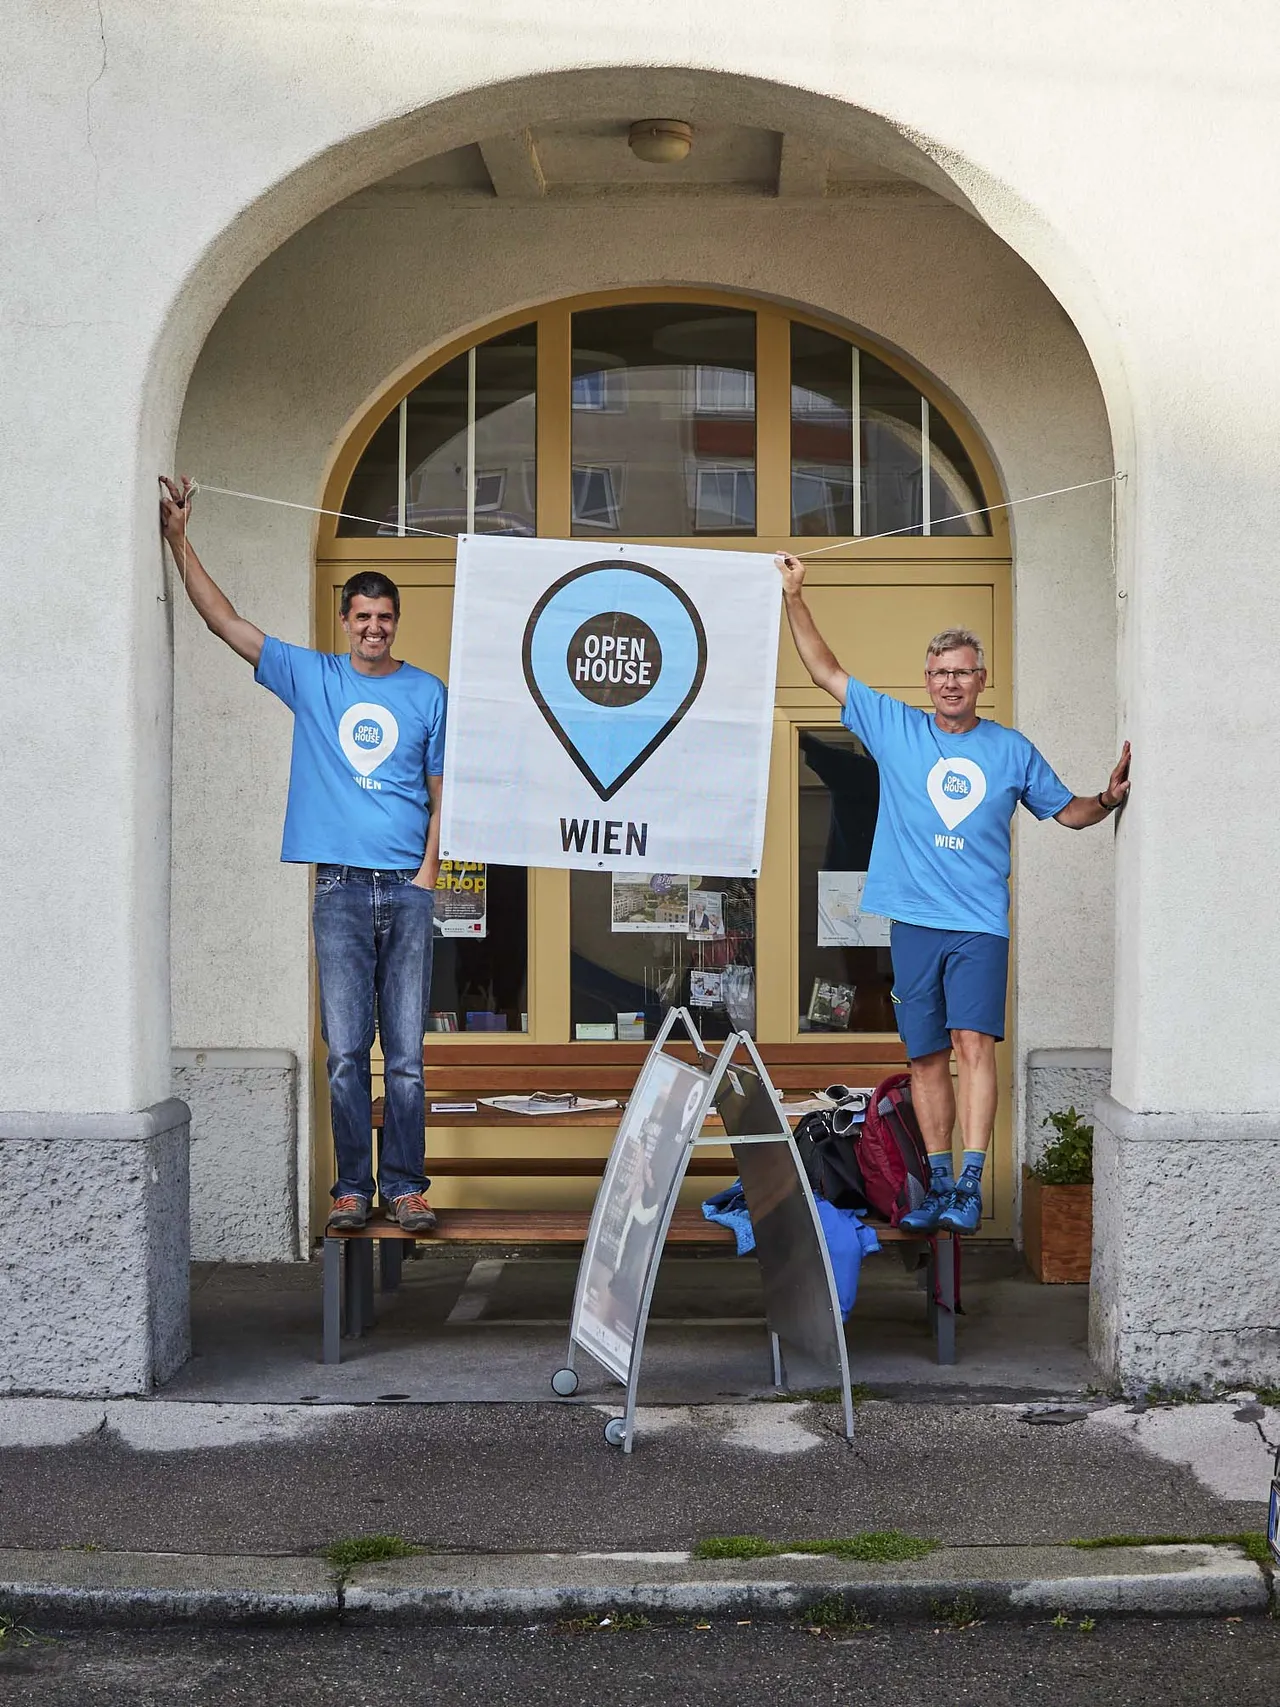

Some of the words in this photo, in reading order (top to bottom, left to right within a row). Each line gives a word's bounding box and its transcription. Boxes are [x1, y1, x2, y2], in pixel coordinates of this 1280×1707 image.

[583, 634, 645, 661] OPEN
[575, 658, 652, 685] HOUSE
[354, 732, 380, 744] HOUSE
[358, 725, 379, 735] OPEN
[944, 784, 969, 794] HOUSE
[947, 776, 966, 786] OPEN
[559, 817, 648, 857] WIEN
[934, 834, 965, 850] WIEN
[435, 873, 486, 893] shop
